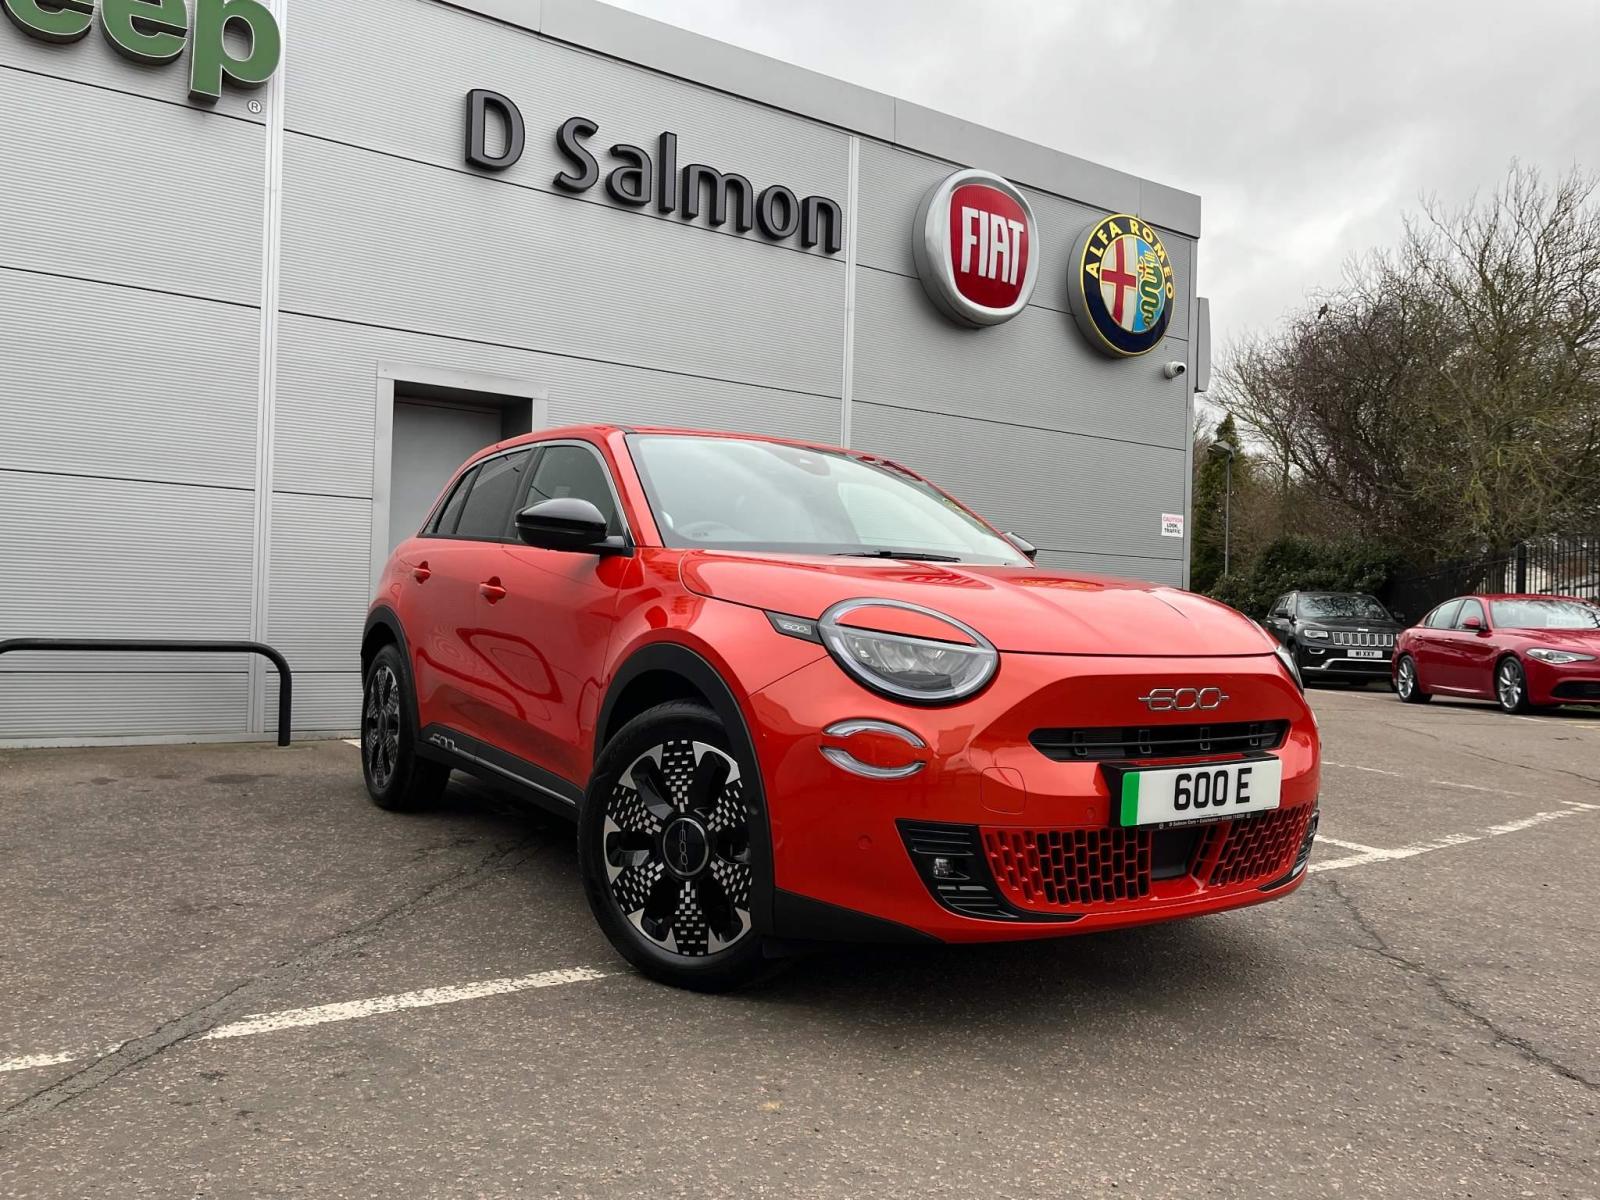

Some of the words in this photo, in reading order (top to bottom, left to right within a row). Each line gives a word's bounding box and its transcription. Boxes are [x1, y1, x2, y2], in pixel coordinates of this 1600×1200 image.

[465, 88, 525, 171] D
[552, 116, 843, 254] Salmon
[961, 206, 1024, 286] FIAT
[1085, 219, 1123, 280] ALFA
[1129, 218, 1174, 300] ROMEO
[1147, 687, 1222, 710] 600
[1174, 770, 1229, 811] 600
[1235, 767, 1253, 805] E
